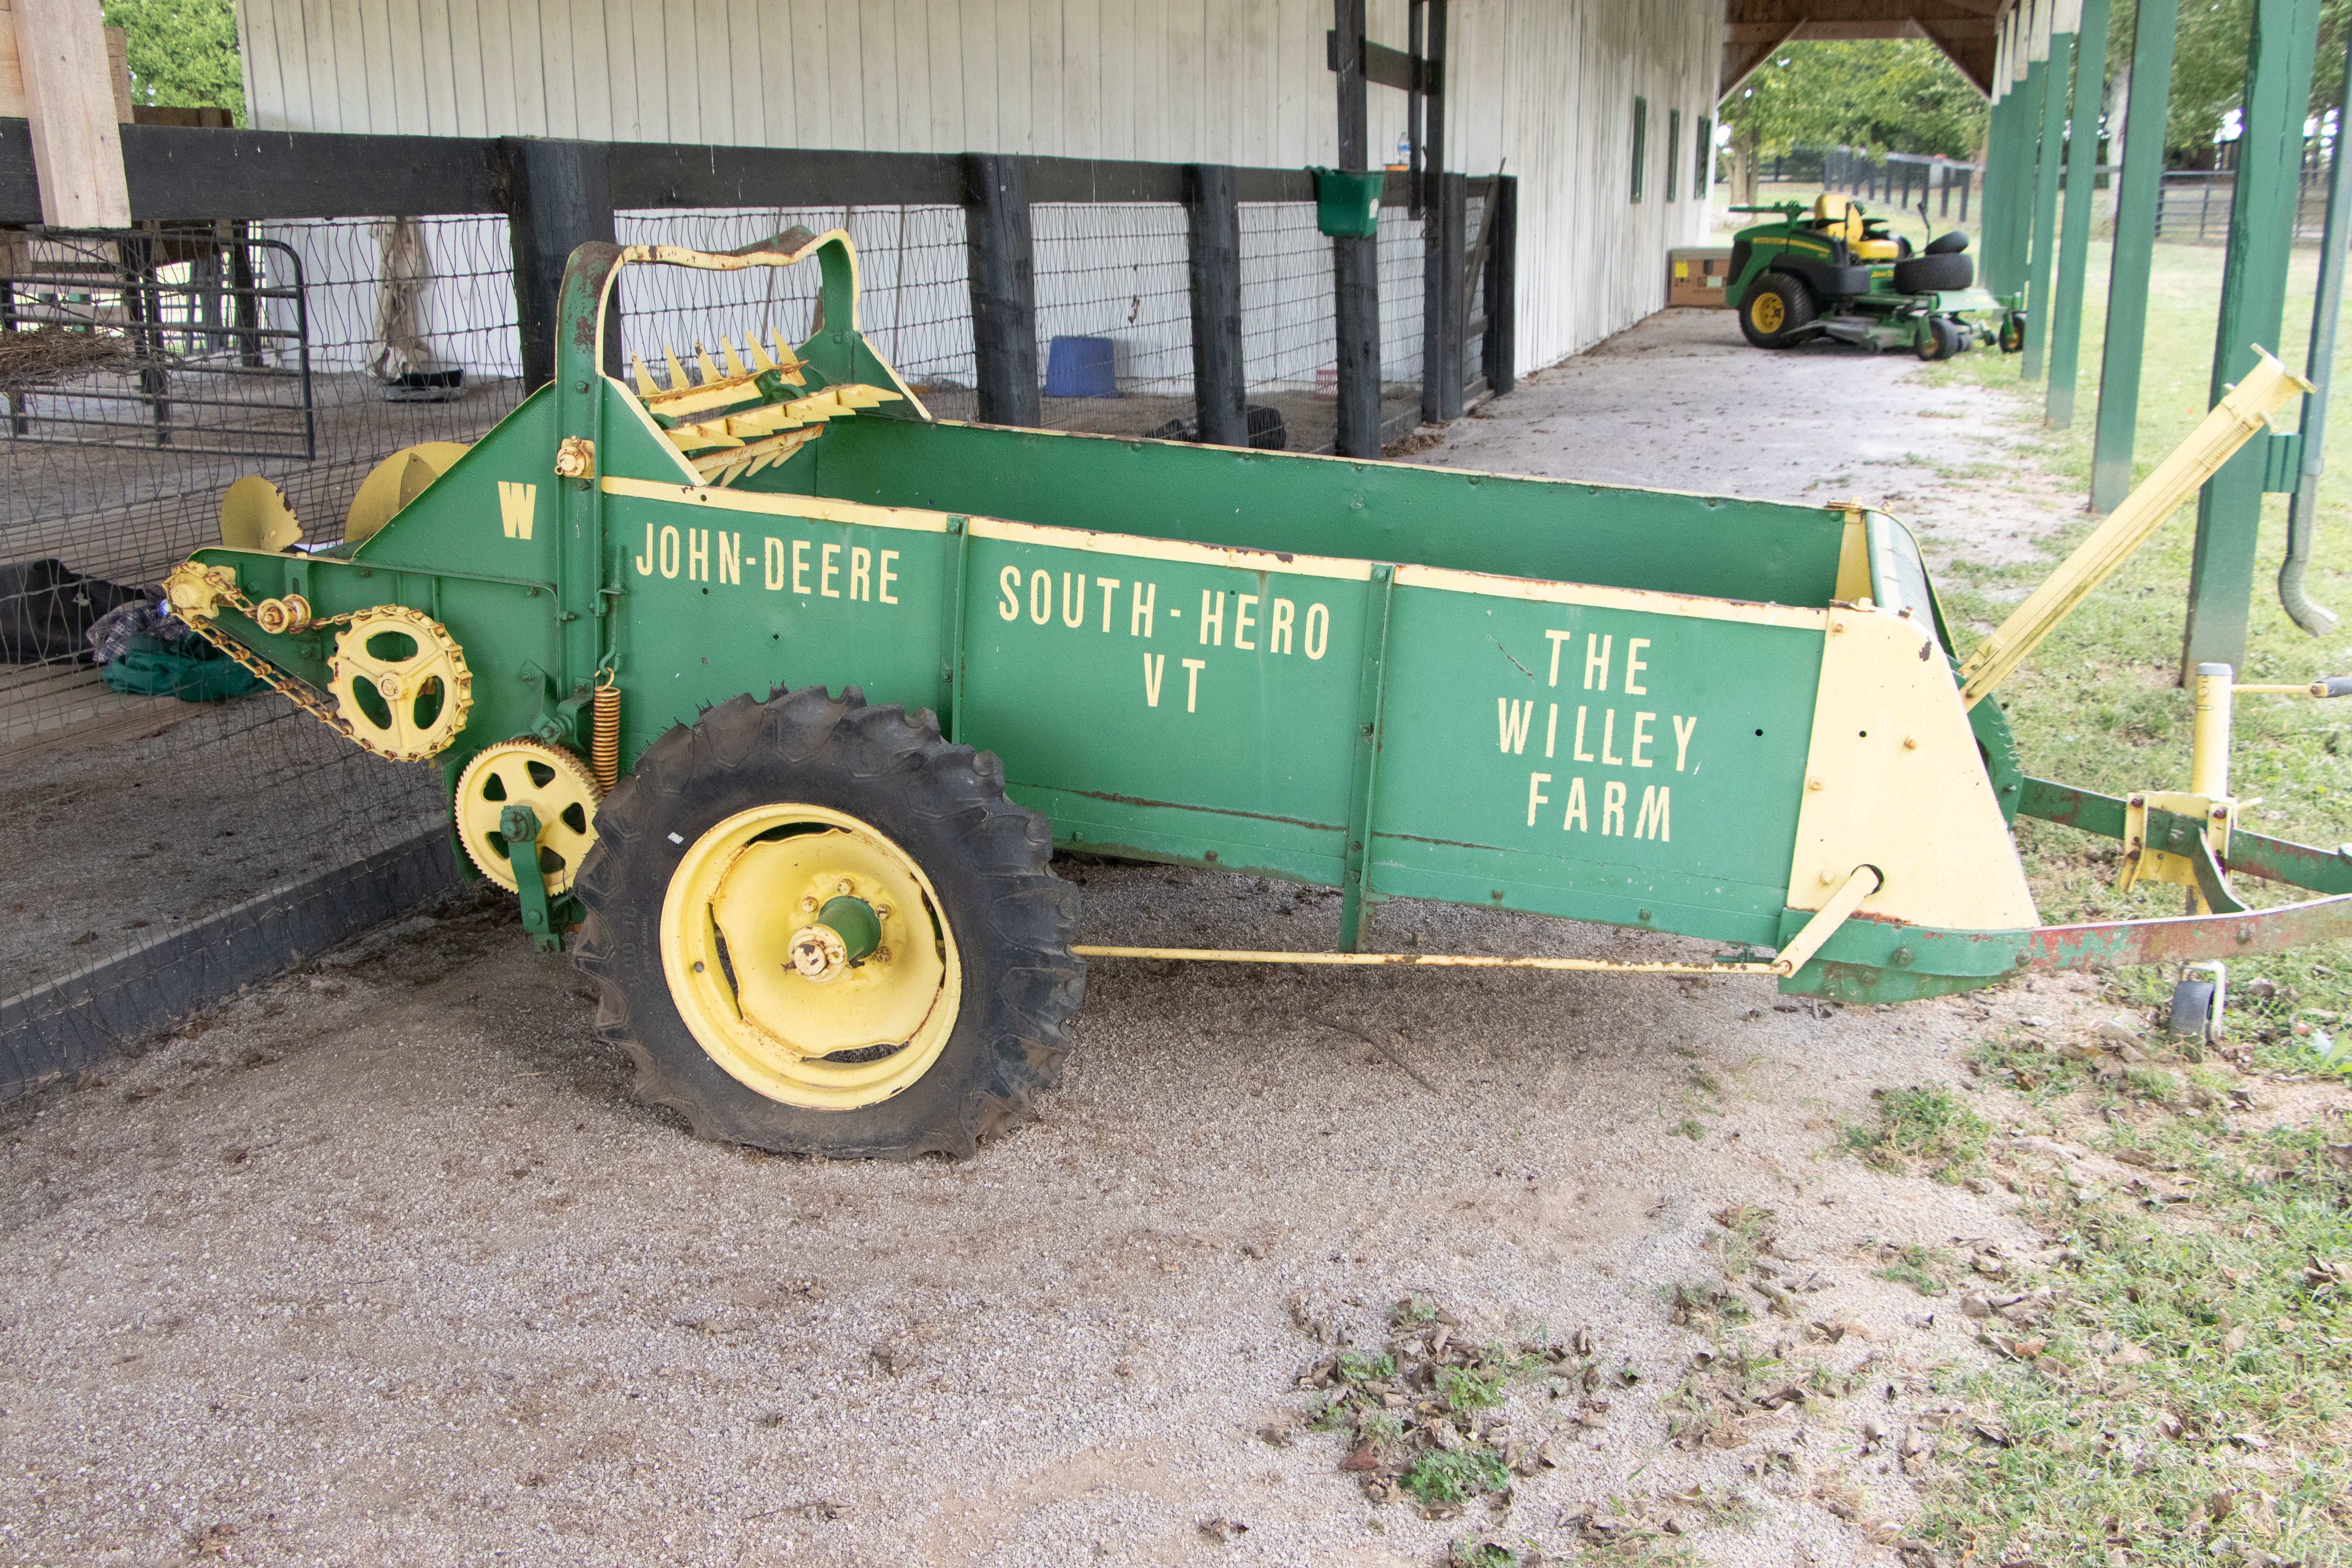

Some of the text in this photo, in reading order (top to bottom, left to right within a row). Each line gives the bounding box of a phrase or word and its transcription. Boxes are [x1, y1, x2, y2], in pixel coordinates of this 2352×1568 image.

[498, 481, 537, 540] W
[636, 523, 900, 604] JOHN-DEERE
[1545, 630, 1651, 695] THE
[1498, 698, 1697, 771] WILLEY
[1527, 772, 1670, 842] FARM
